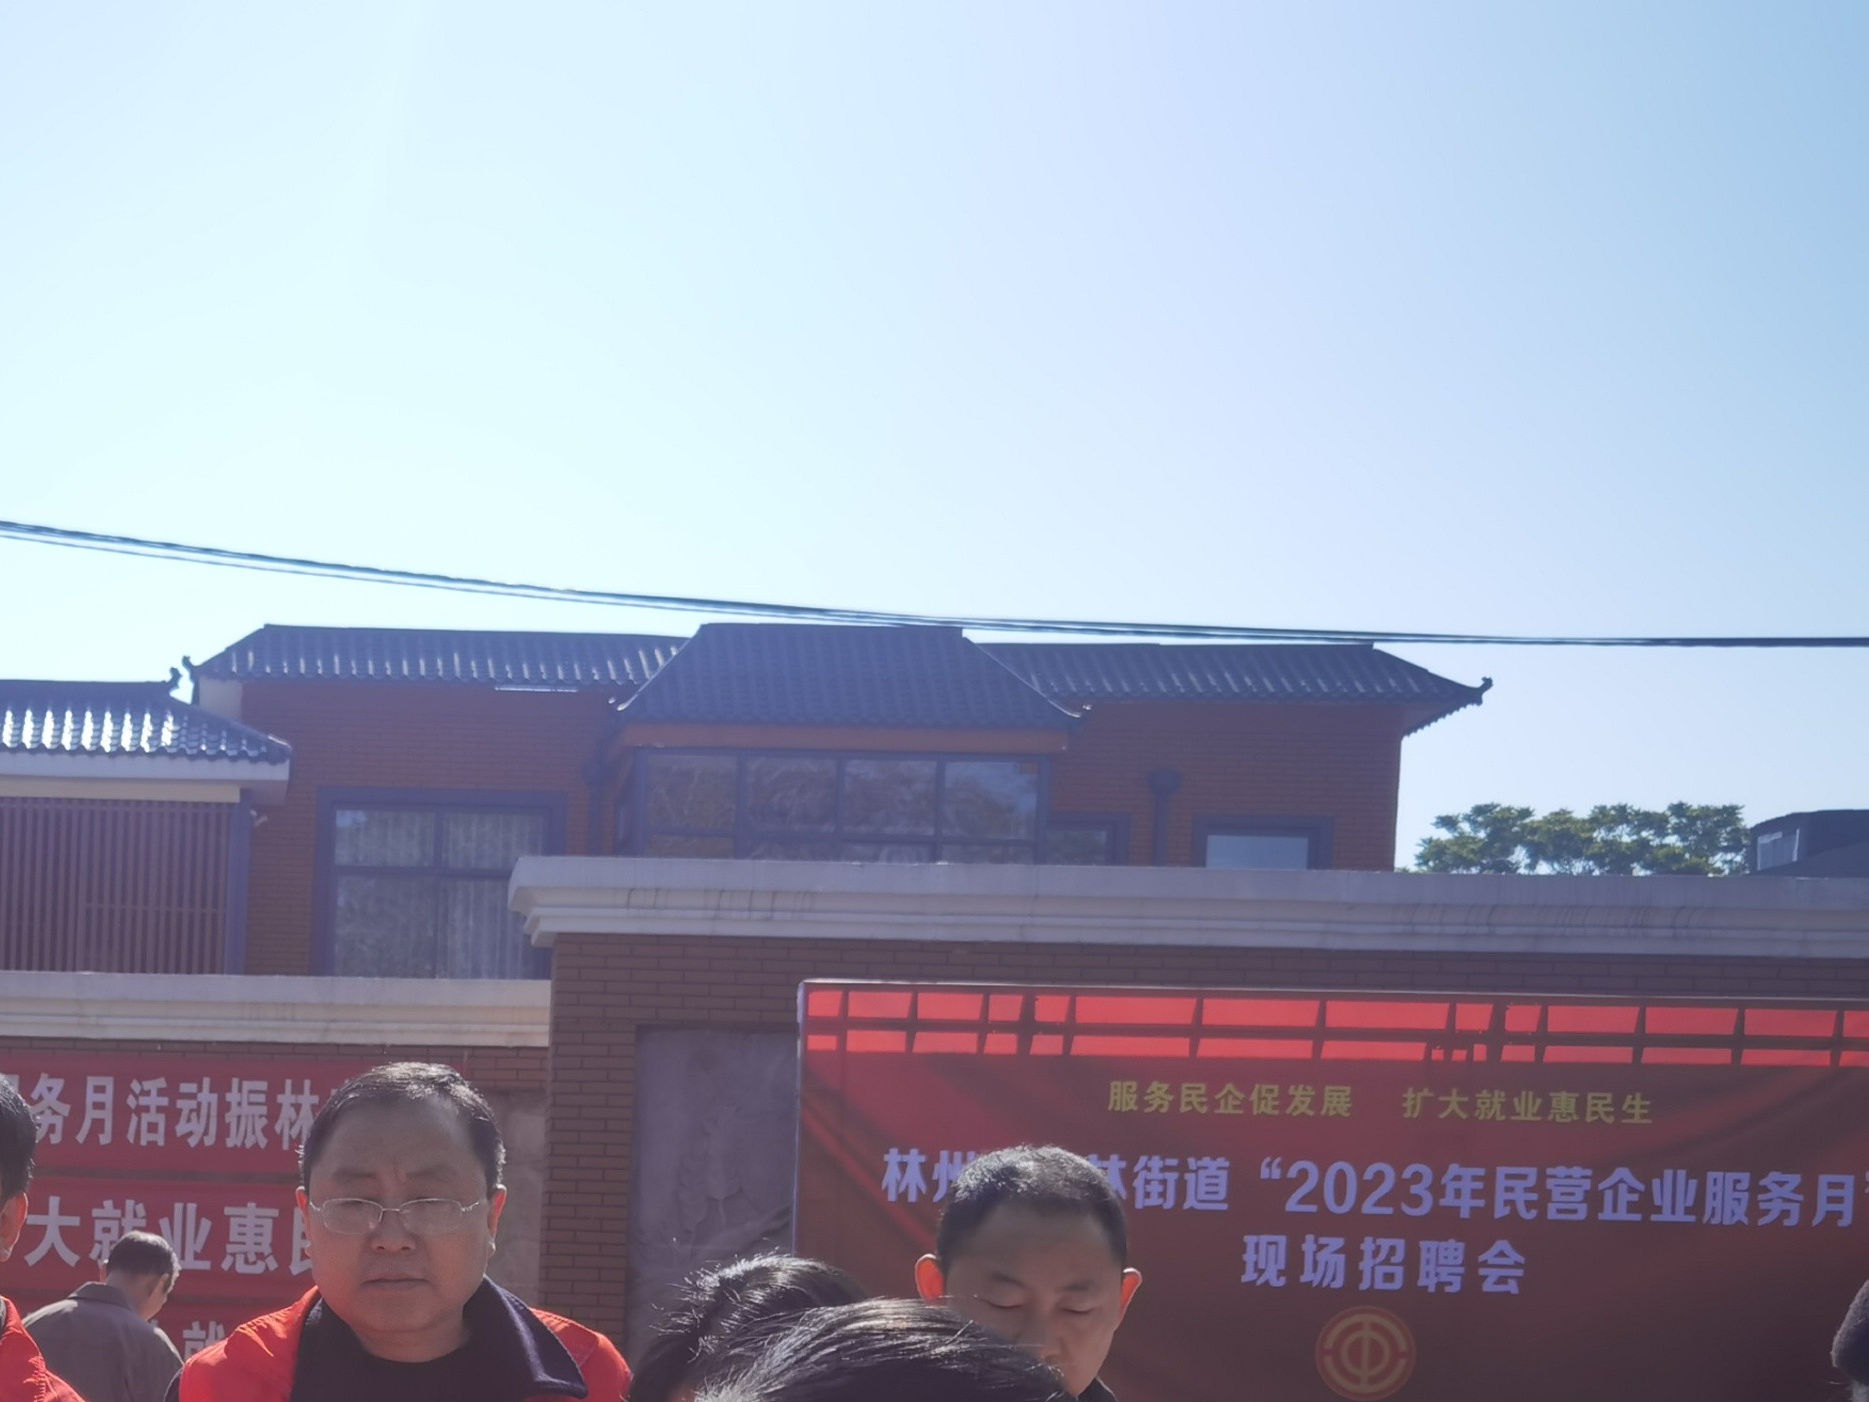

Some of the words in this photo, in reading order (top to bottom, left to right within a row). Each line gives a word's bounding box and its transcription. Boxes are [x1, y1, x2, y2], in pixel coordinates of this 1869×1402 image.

[1107, 1078, 1353, 1119] 服务民企促发展
[1403, 1087, 1654, 1125] 扩大就业惠民生
[1241, 1233, 1527, 1295] 现场招聘会
